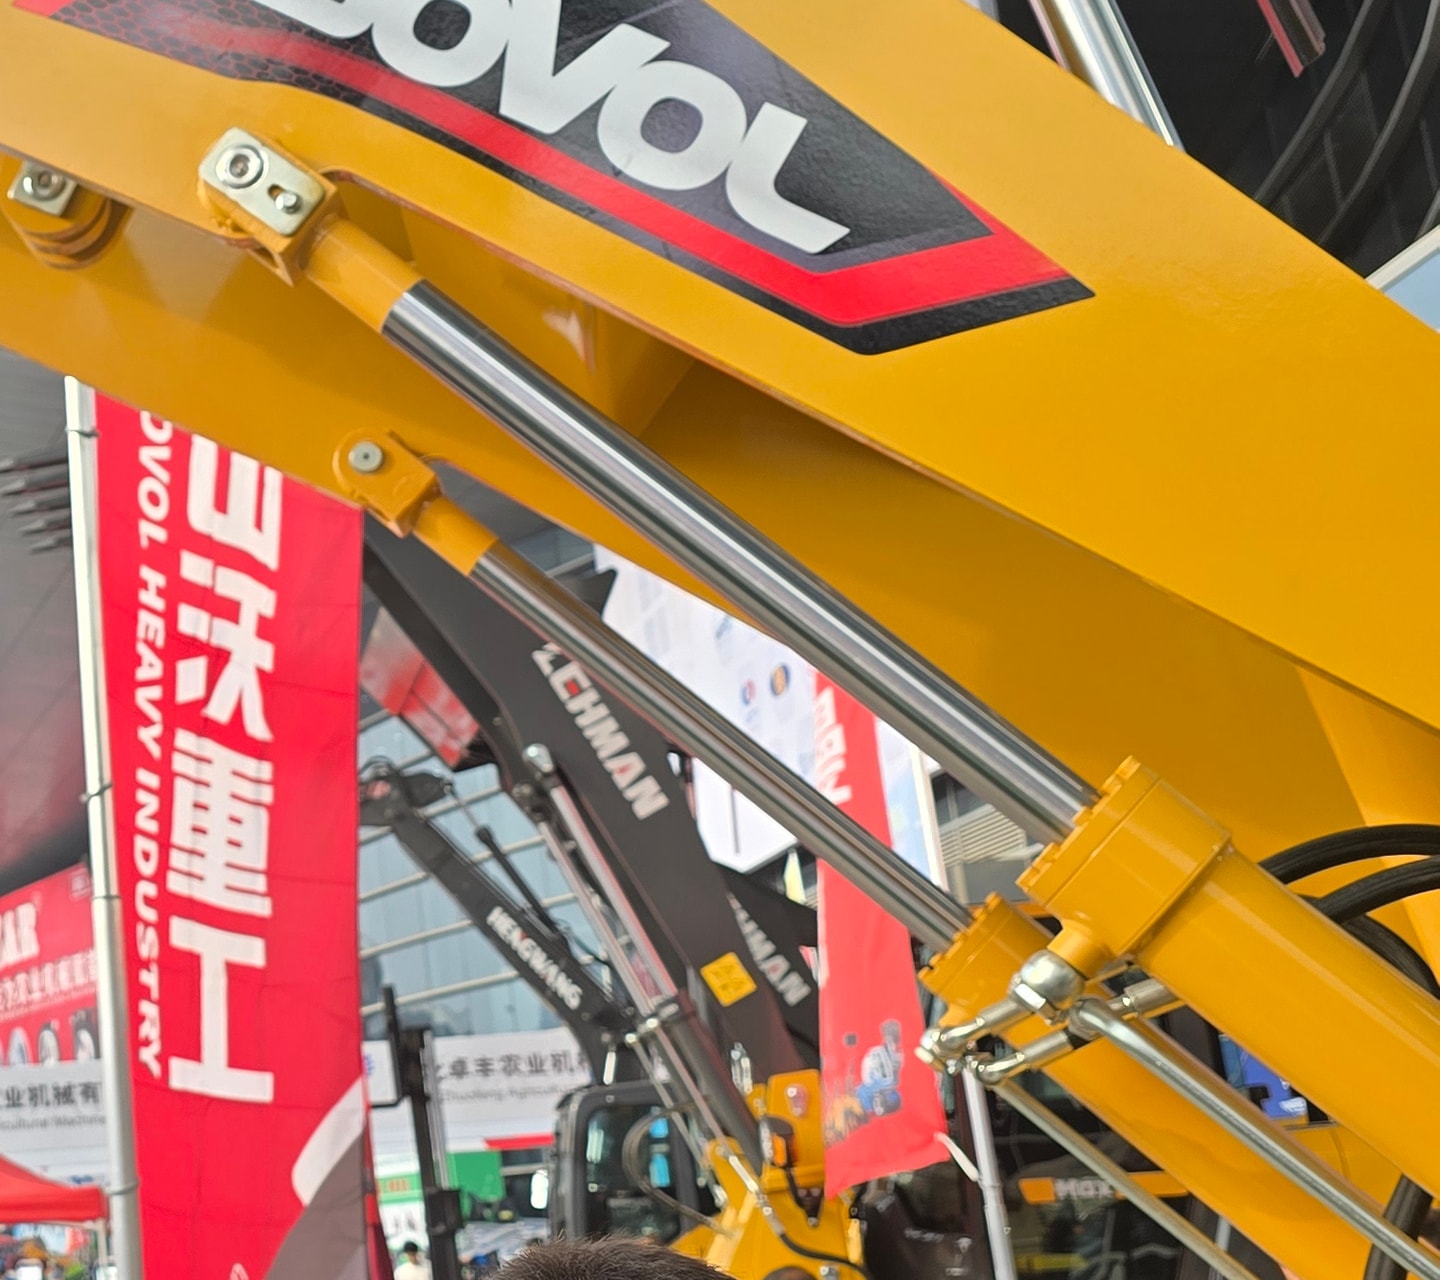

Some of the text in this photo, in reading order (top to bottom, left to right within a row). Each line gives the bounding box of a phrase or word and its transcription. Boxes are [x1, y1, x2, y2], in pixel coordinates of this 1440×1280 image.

[133, 410, 173, 1079] OVOL HEAVY INDUSTRY
[166, 433, 283, 1104] 山沃重工
[532, 642, 670, 820] LEHMAN
[486, 906, 583, 1010] HENGWANG
[726, 892, 812, 1008] HMAN
